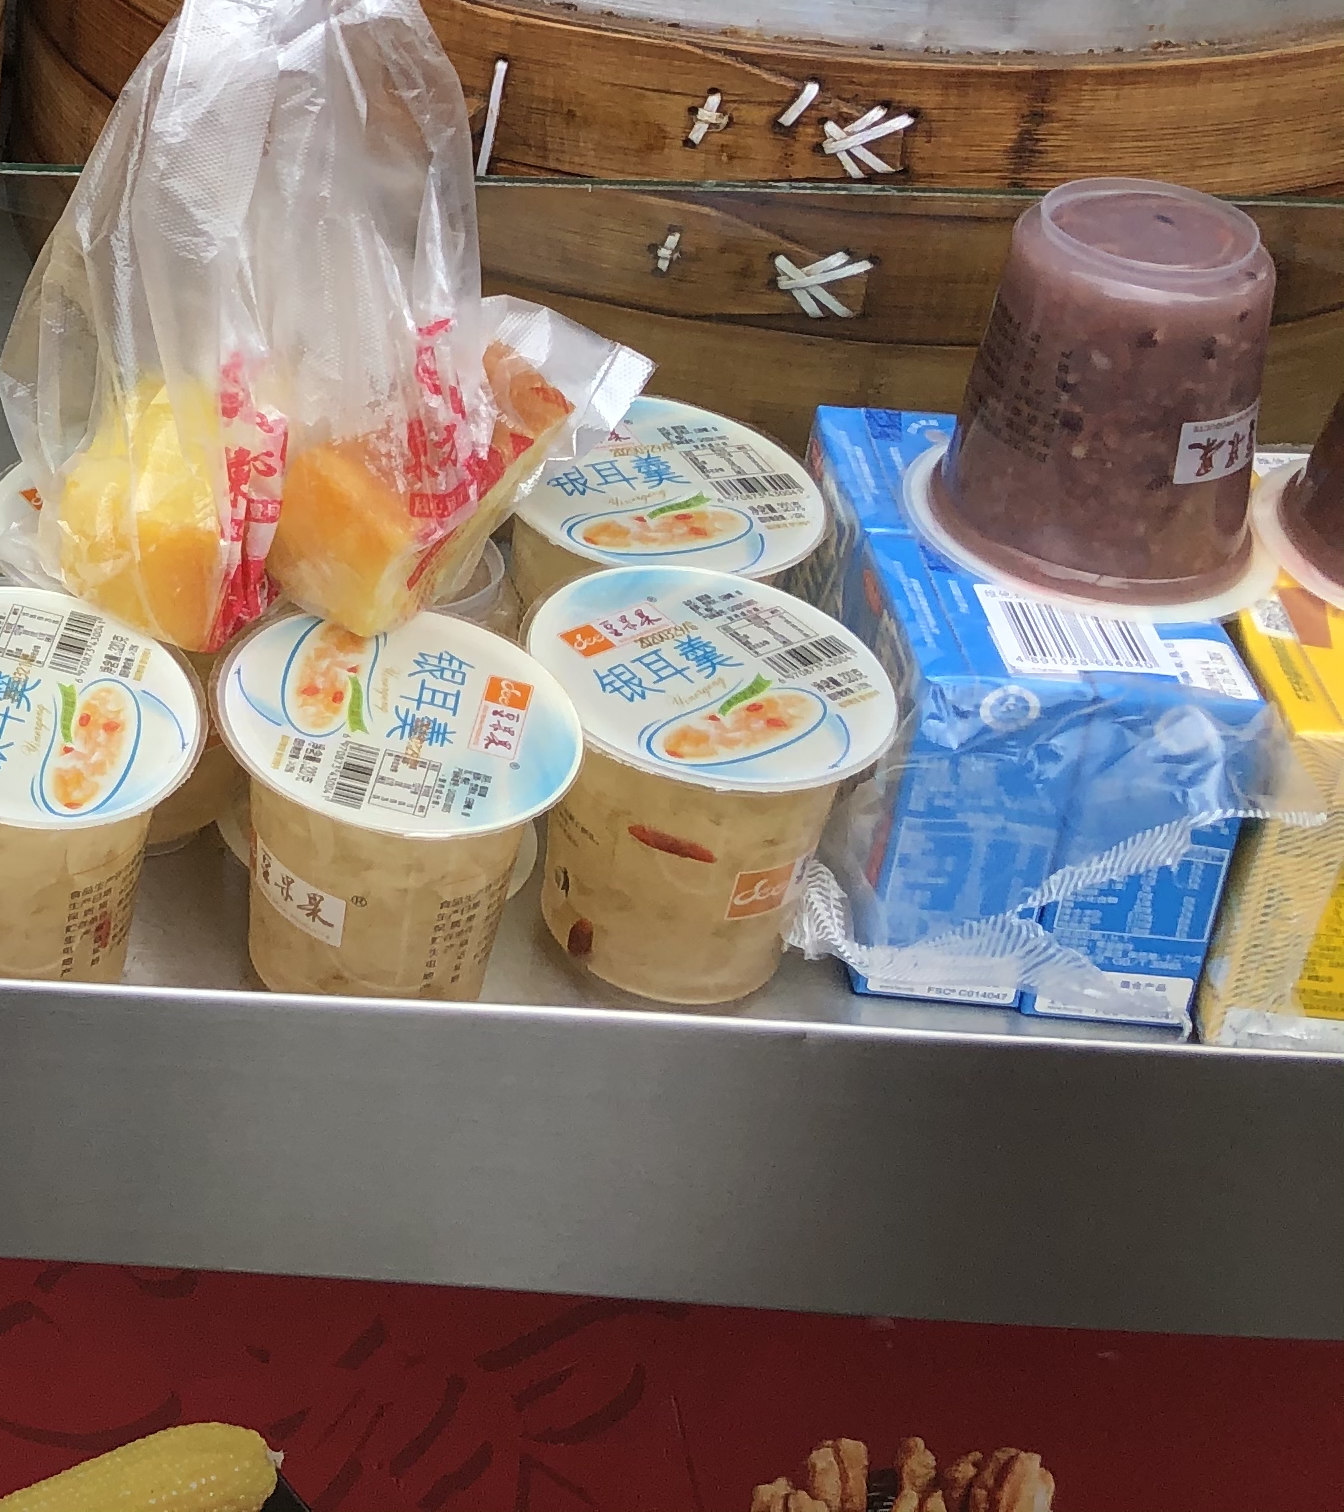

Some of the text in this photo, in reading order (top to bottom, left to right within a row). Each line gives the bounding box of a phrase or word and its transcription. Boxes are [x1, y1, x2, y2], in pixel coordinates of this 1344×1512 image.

[546, 452, 692, 498] 银耳羹
[593, 633, 744, 704] 银耳羹
[385, 649, 476, 750] 银耳羹
[957, 989, 1009, 1002] C014047
